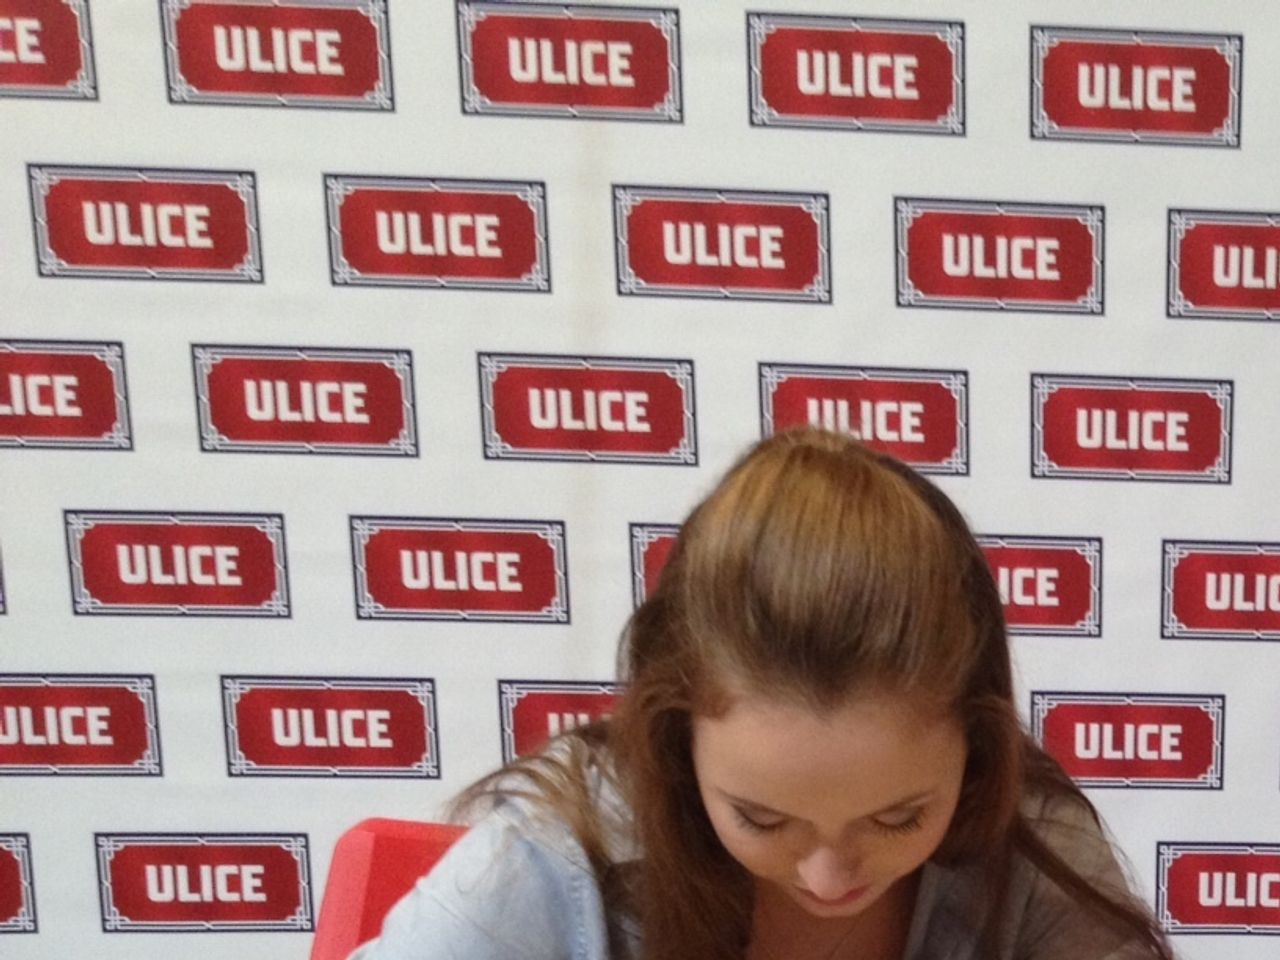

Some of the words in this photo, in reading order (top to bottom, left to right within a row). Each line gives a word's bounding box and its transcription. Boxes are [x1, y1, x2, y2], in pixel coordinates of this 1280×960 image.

[214, 27, 344, 75] ULICE
[509, 38, 634, 86] ULICE
[797, 51, 919, 99] ULICE
[1079, 64, 1196, 112] ULICE
[84, 202, 213, 248] ULICE
[377, 212, 502, 257] ULICE
[664, 223, 784, 268] ULICE
[943, 235, 1060, 280] ULICE
[245, 380, 369, 423] ULICE
[529, 389, 650, 432] ULICE
[1077, 409, 1189, 451] ULICE
[118, 545, 242, 585] ULICE
[401, 551, 522, 591] ULICE
[997, 567, 1060, 606] ICE
[272, 709, 393, 747] ULICE
[1074, 722, 1183, 760] ULICE
[146, 865, 267, 902] ULICE
